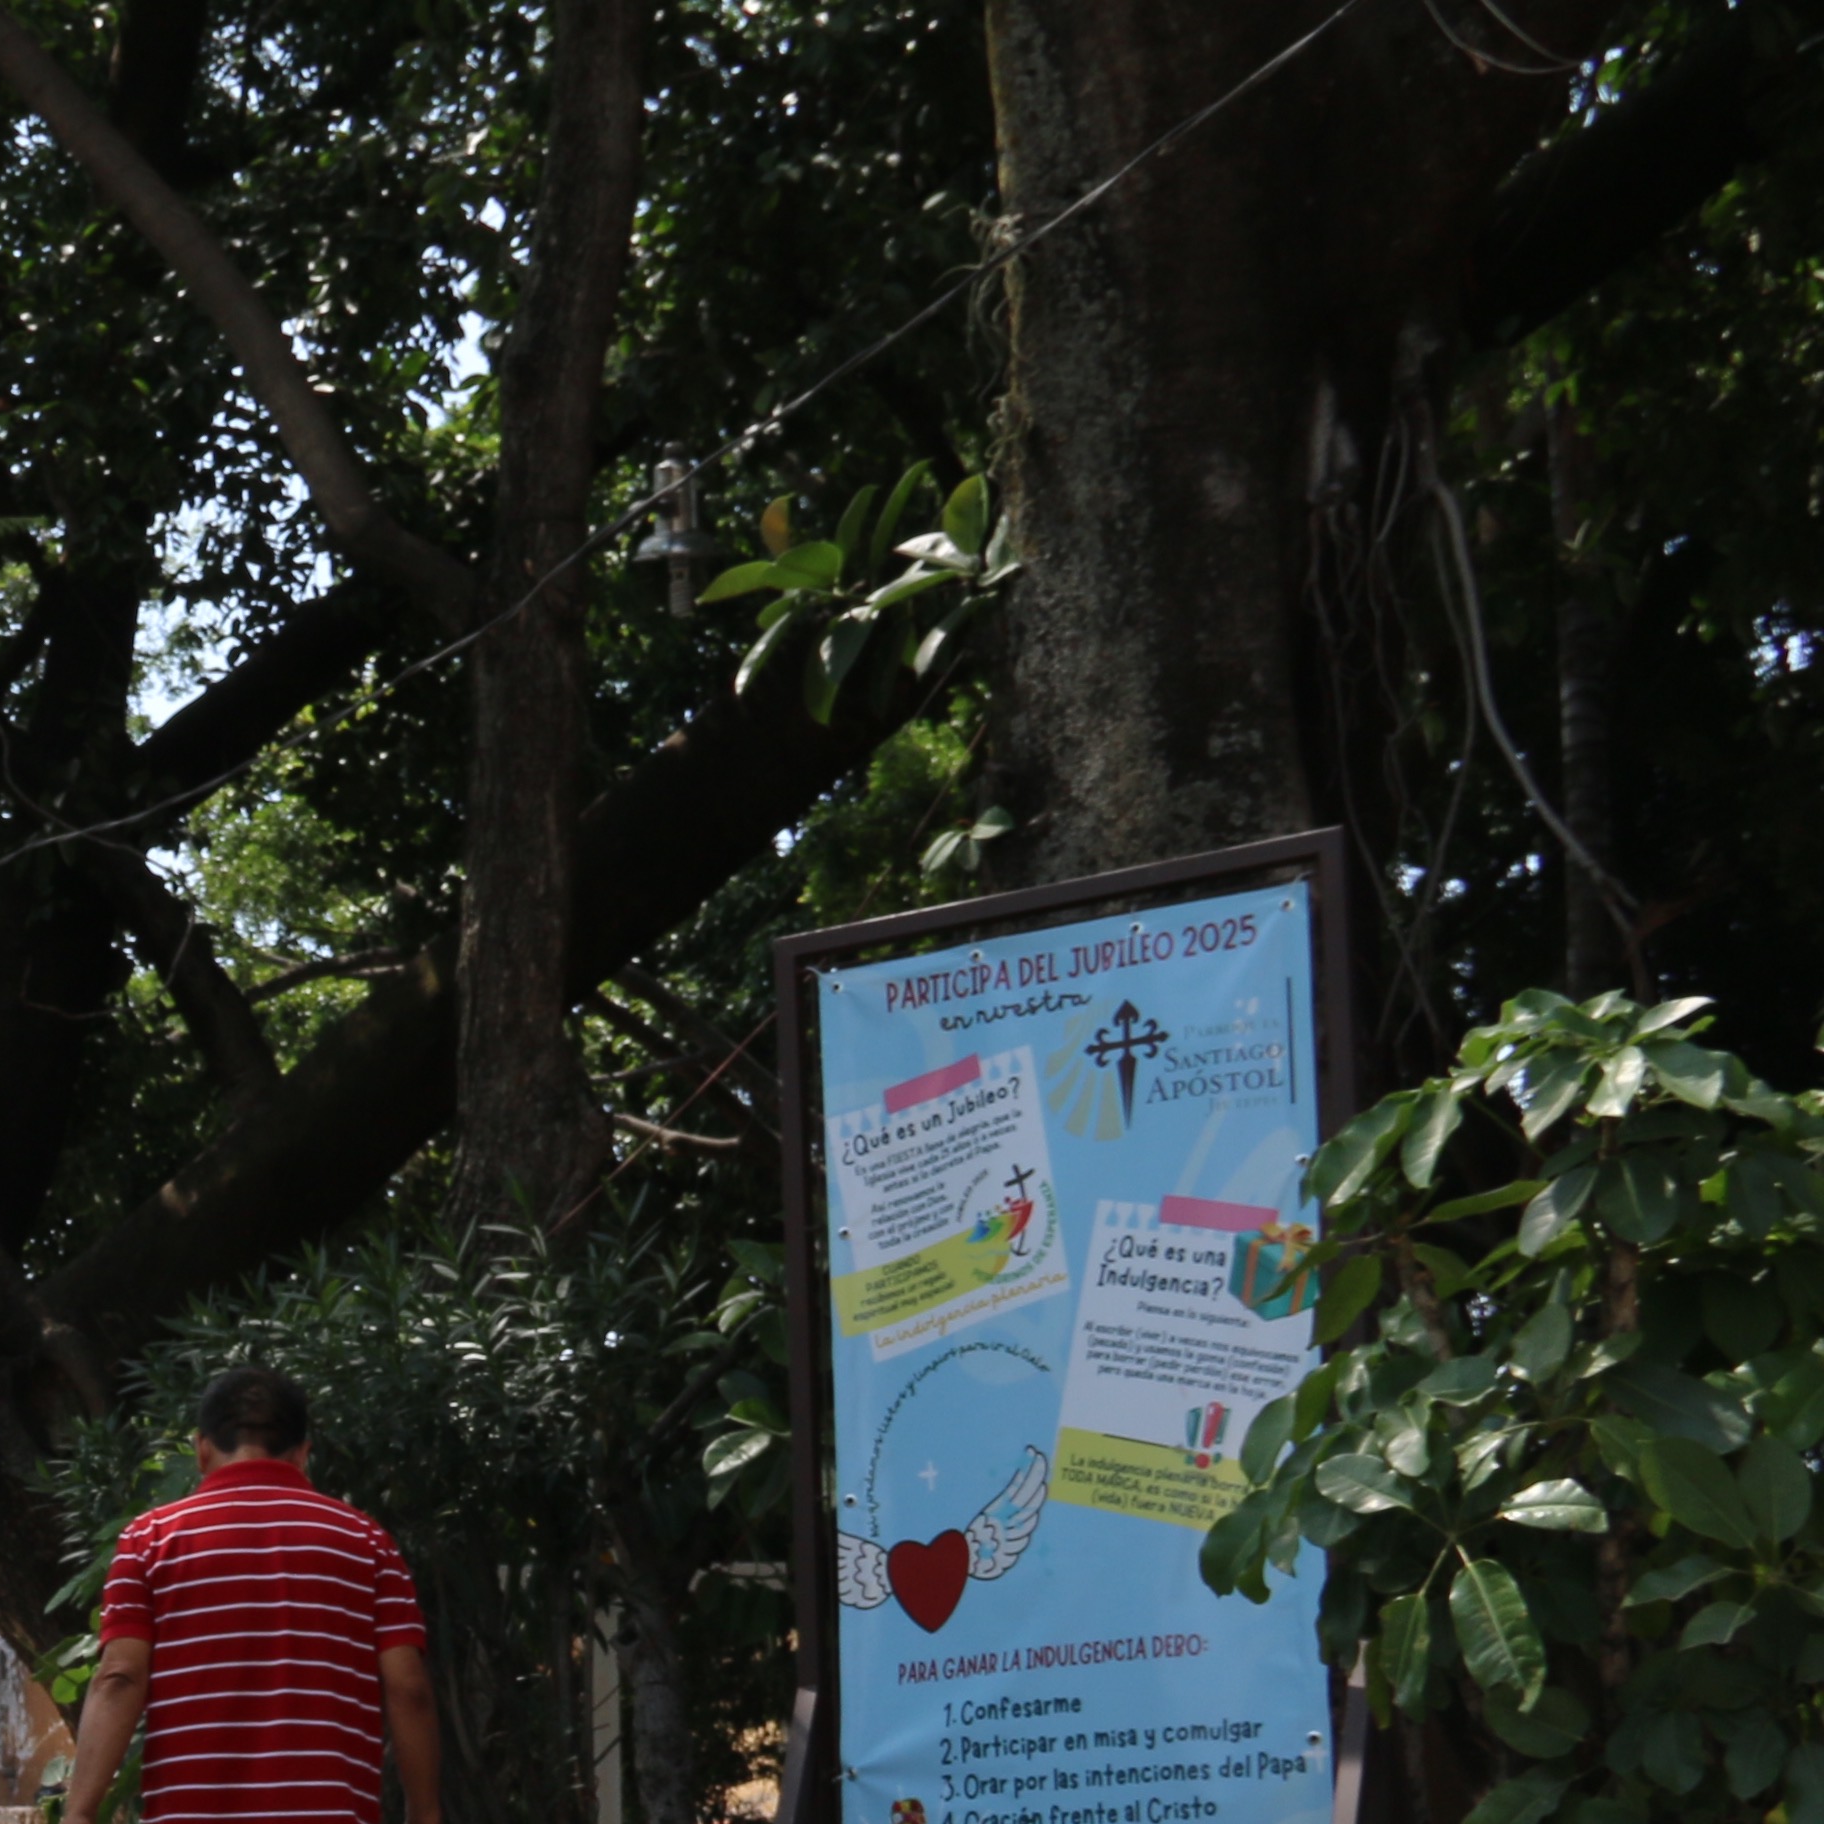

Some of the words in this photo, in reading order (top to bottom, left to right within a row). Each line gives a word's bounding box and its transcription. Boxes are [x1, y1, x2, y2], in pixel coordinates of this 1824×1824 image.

[887, 961, 1011, 1012] PARTICIPA
[1019, 953, 1059, 987] DEL
[1068, 930, 1174, 977] JUBILEO
[1182, 914, 1257, 956] 2025
[1164, 1043, 1284, 1073] SANTIAGO
[1146, 1069, 1284, 1104] APÓSTOL
[842, 1127, 890, 1165] ¿Qué
[897, 1122, 917, 1140] es
[921, 1113, 942, 1132] un
[947, 1077, 1020, 1124] Jubileo?
[887, 1147, 923, 1166] FIESTA
[1103, 1235, 1158, 1264] ¿Qué
[1164, 1248, 1186, 1262] es
[1192, 1250, 1228, 1267] una
[1097, 1263, 1224, 1302] Indulgencia?
[1061, 1467, 1094, 1484] TODA
[1146, 1482, 1161, 1495] es
[1163, 1486, 1200, 1501] como
[1087, 1455, 1153, 1480] indulgencia
[1131, 1495, 1166, 1513] fuera
[898, 1659, 939, 1685] PARA
[943, 1652, 998, 1680] GANAR
[1002, 1648, 1022, 1673] LA
[1025, 1637, 1147, 1670] INDULGENCIA
[1152, 1633, 1210, 1658] DEBO:
[943, 1702, 957, 1729] 1.
[960, 1695, 1083, 1727] Confesarme
[940, 1738, 959, 1765] 2.
[961, 1734, 1057, 1764] Participar
[1064, 1731, 1088, 1751] en
[1094, 1725, 1138, 1749] misa
[1145, 1724, 1157, 1750] y
[1162, 1717, 1264, 1746] comulgar
[940, 1773, 960, 1802] 3.
[963, 1773, 1009, 1800] Orar
[1013, 1774, 1048, 1799] por
[1053, 1767, 1079, 1791] las
[1085, 1758, 1211, 1788] intenciones
[1218, 1754, 1252, 1779] del
[1257, 1750, 1308, 1783] Papa
[1125, 1798, 1142, 1824] al
